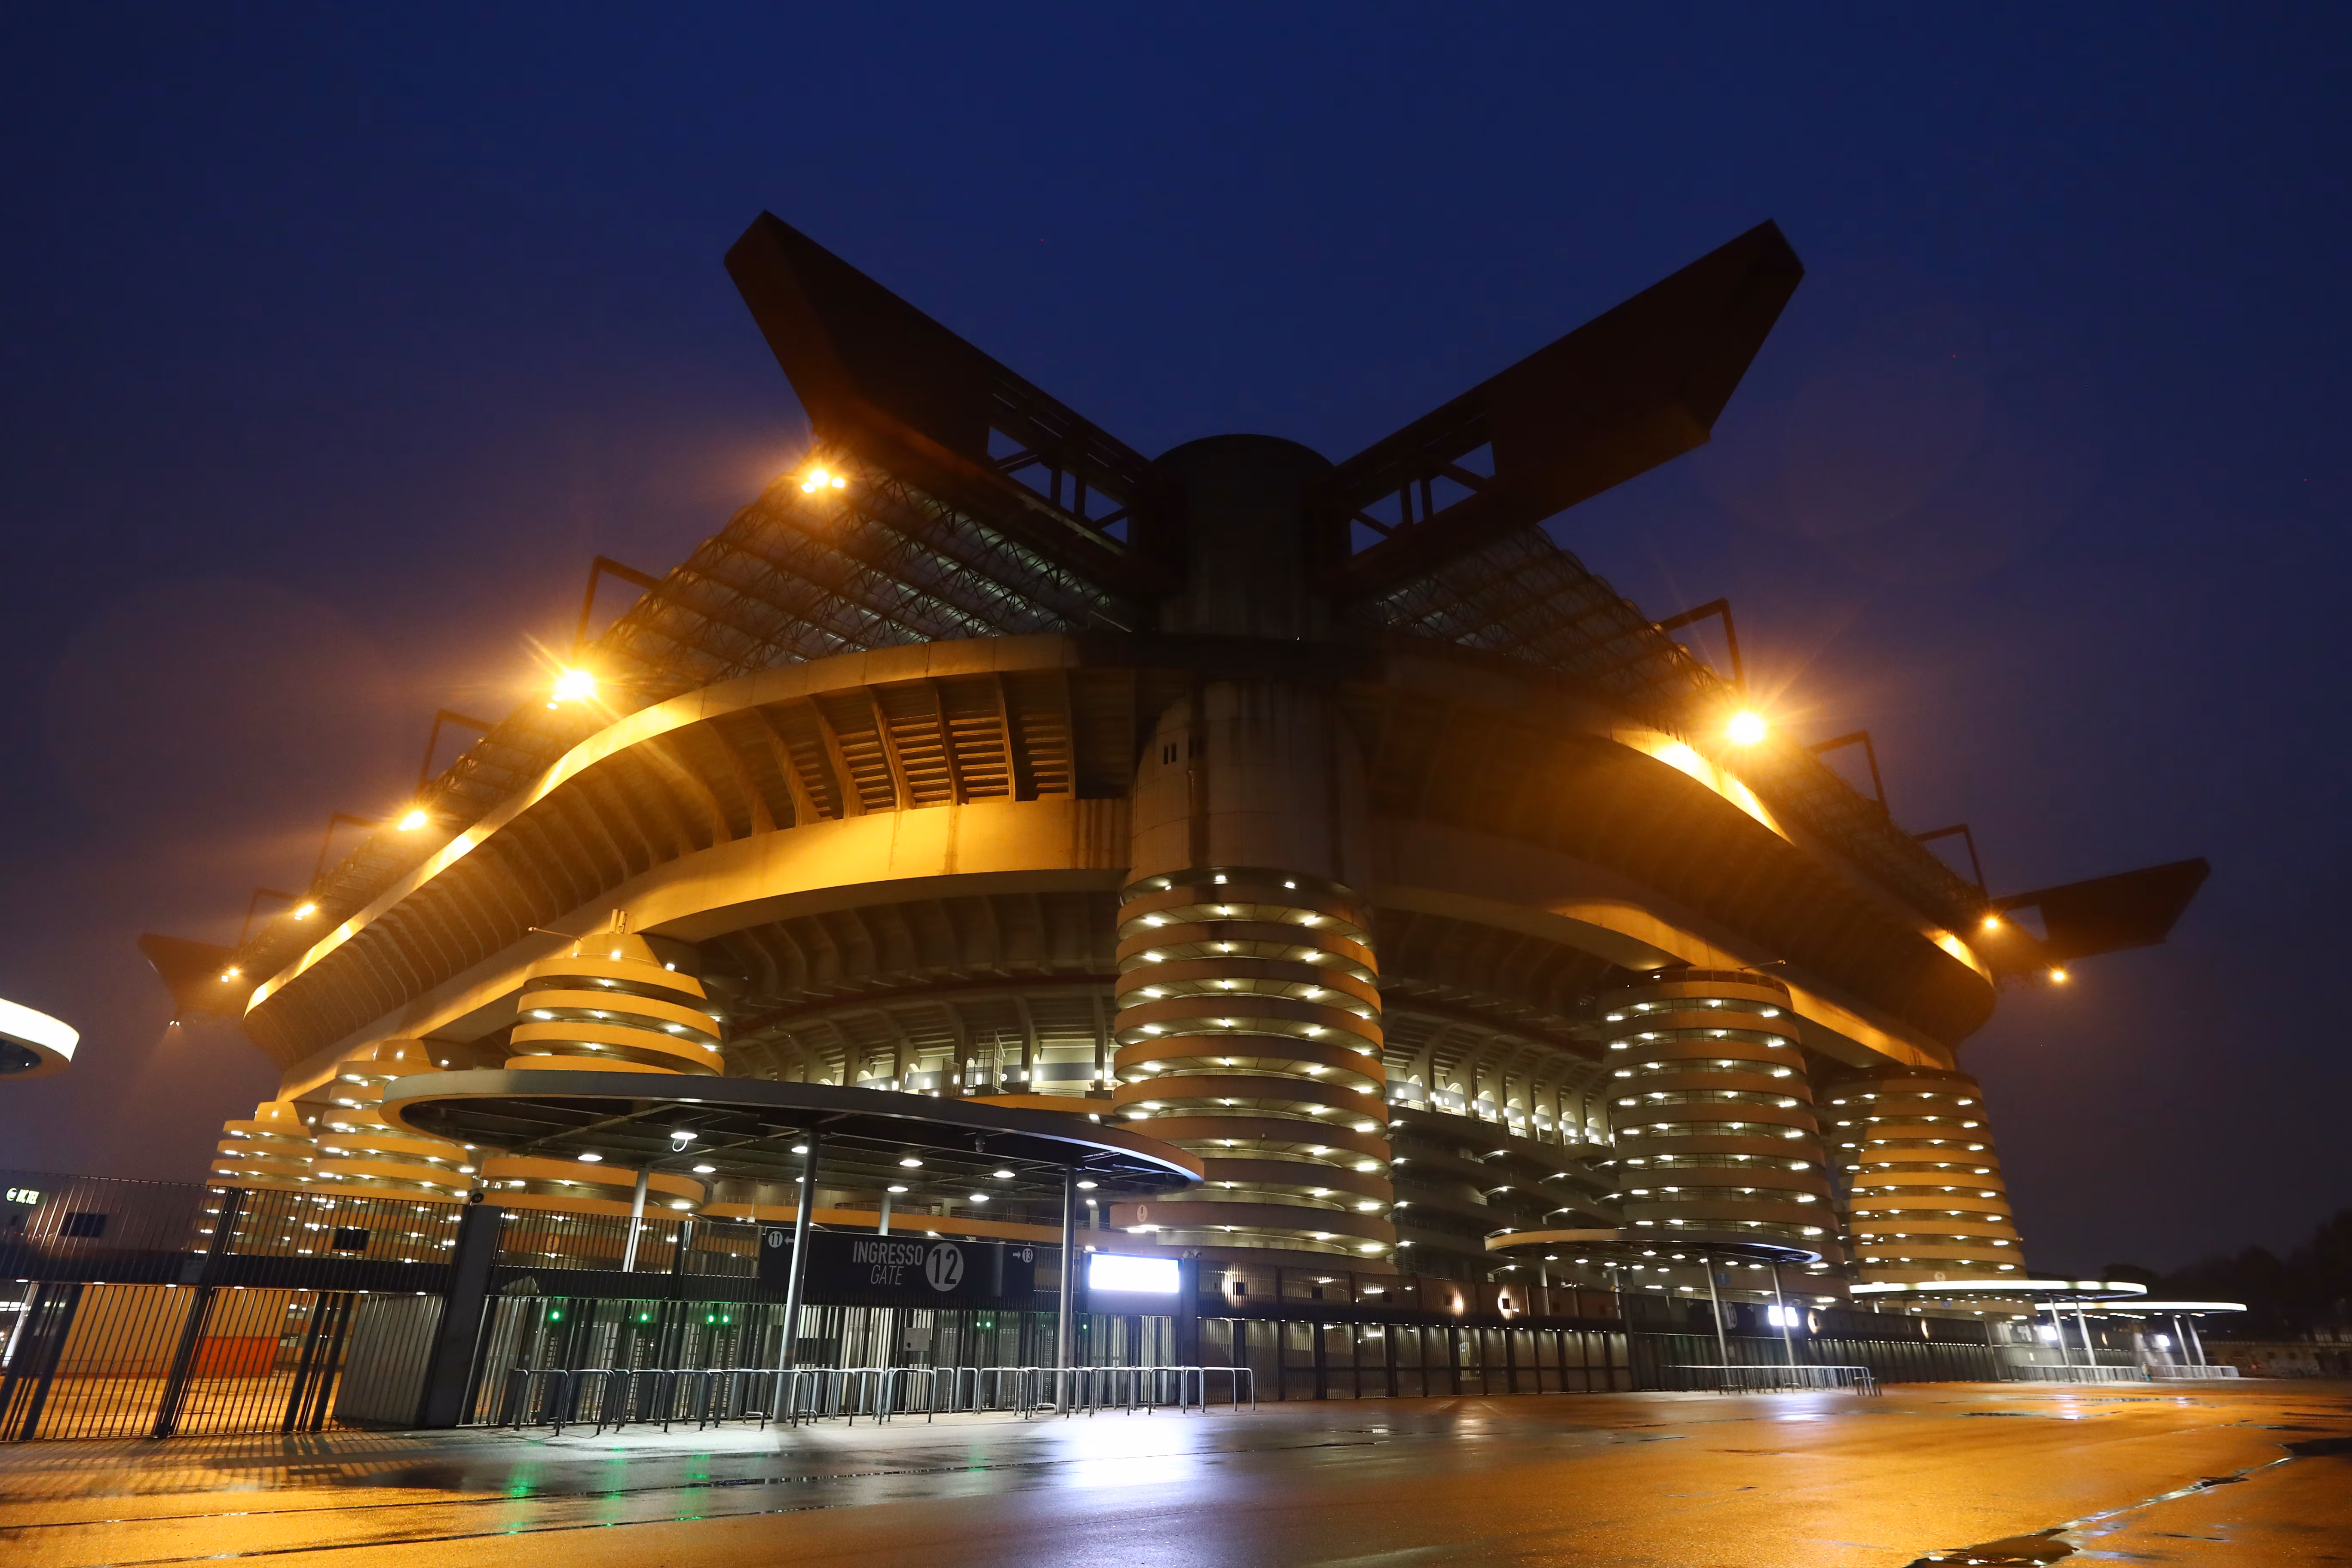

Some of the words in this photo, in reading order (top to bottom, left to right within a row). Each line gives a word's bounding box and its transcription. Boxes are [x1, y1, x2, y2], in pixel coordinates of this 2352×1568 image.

[772, 1233, 780, 1246] 11
[853, 1241, 924, 1265] INGRESSO
[1024, 1250, 1031, 1261] 13
[870, 1265, 904, 1285] GATE
[932, 1248, 958, 1284] 12
